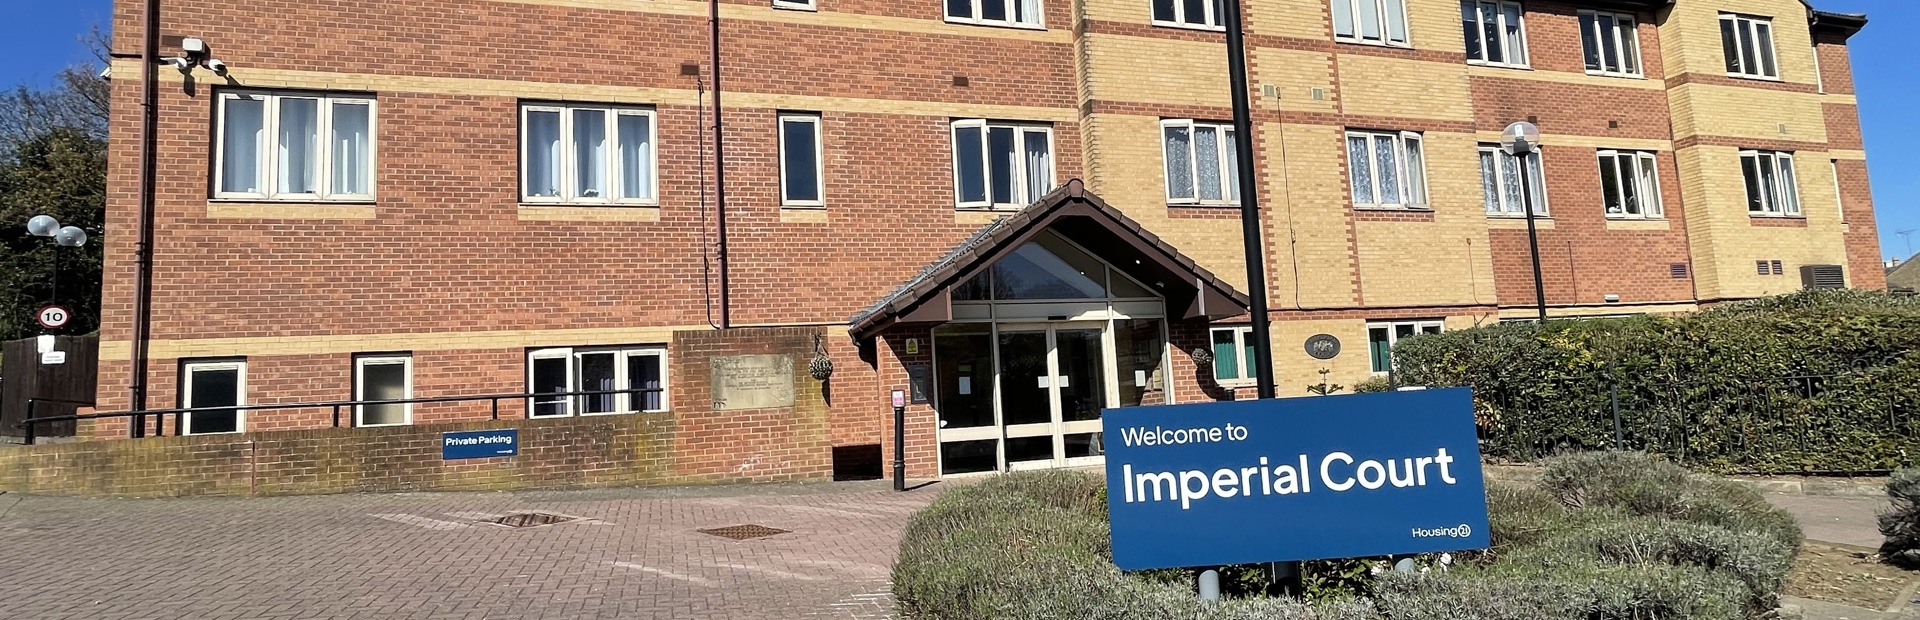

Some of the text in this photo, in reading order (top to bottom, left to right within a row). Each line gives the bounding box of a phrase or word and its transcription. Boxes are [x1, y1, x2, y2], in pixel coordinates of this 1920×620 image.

[45, 313, 63, 321] 10
[445, 435, 512, 446] Private Parking
[1121, 422, 1248, 446] Welcome to
[1123, 447, 1457, 510] Imperial Court
